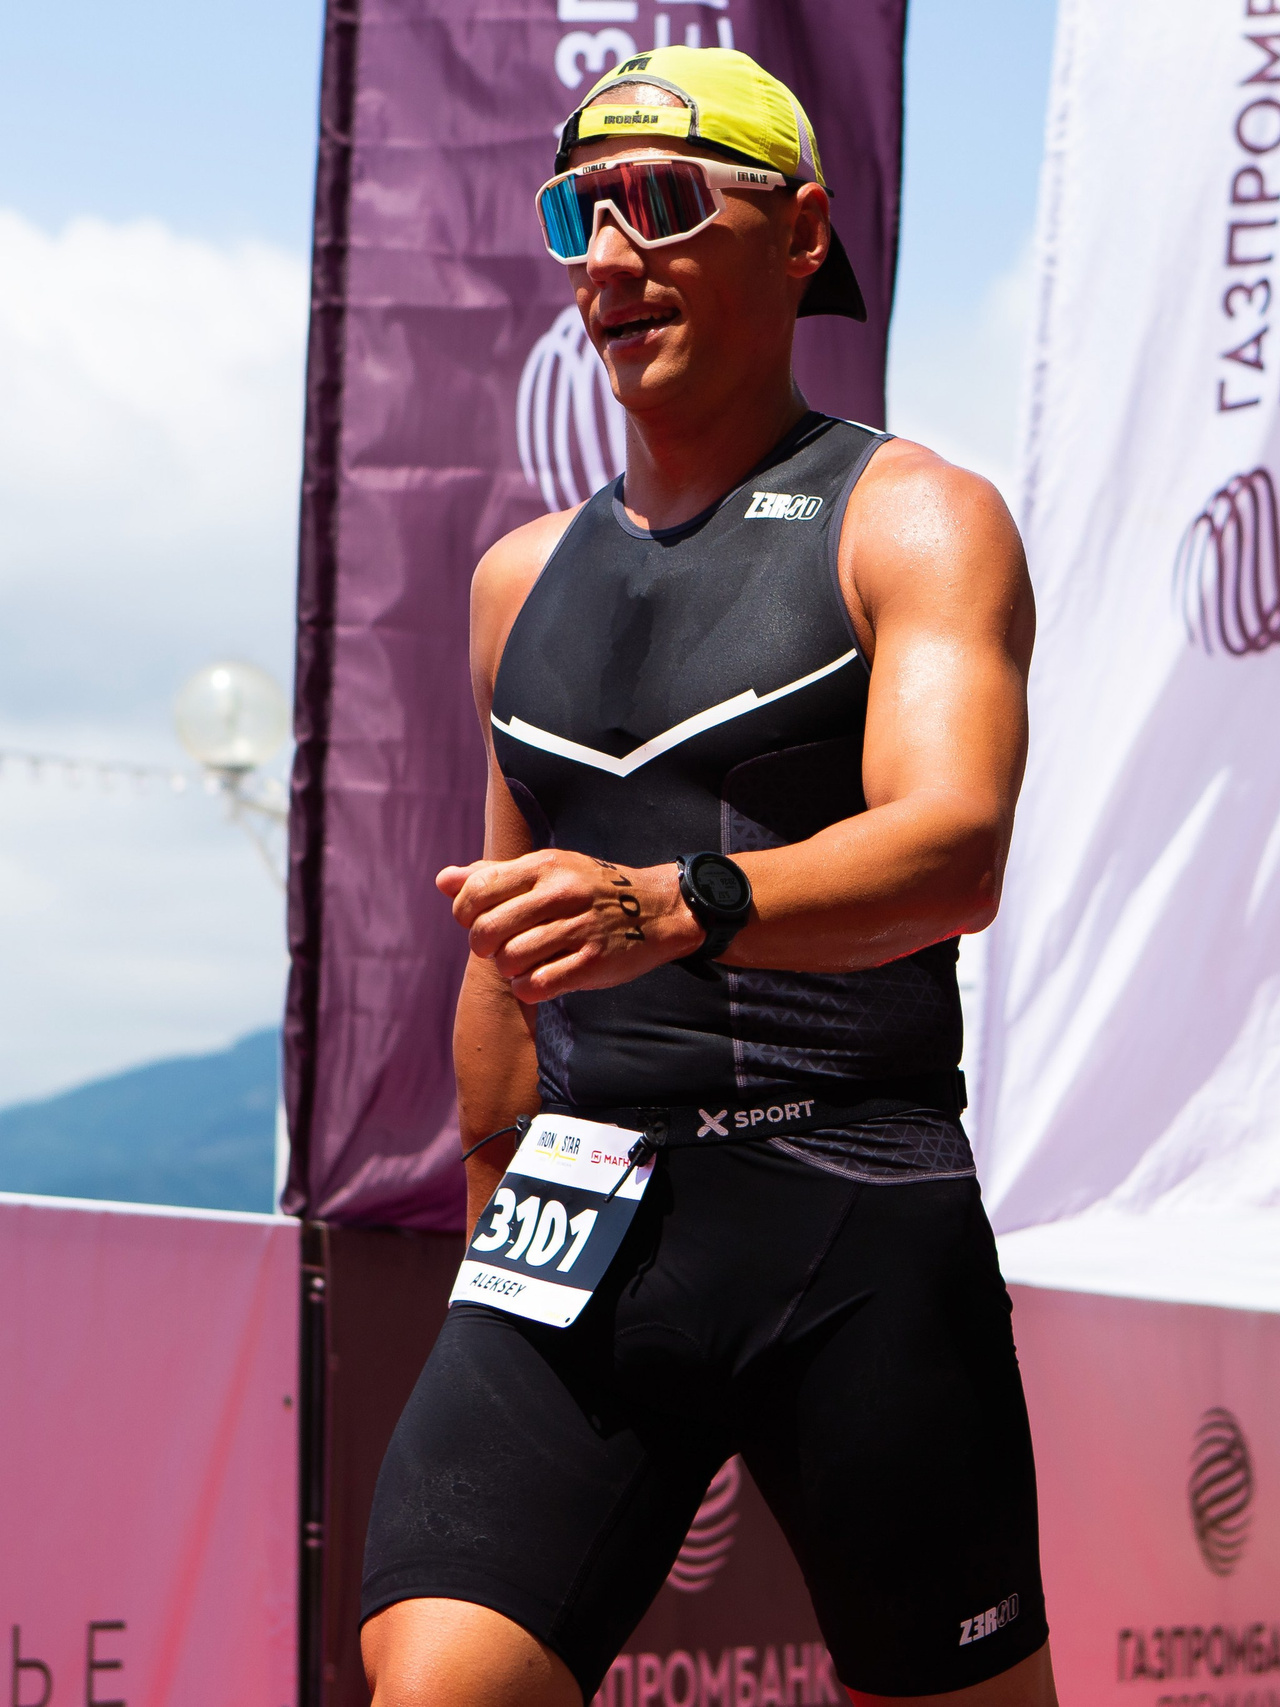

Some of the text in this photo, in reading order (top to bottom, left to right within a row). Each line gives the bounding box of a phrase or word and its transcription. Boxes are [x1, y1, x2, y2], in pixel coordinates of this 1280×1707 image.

[603, 111, 659, 125] IRONMAN
[733, 1099, 816, 1129] SPORT
[536, 1130, 581, 1155] IRON STAR
[603, 1154, 631, 1168] МАГН
[471, 1187, 599, 1273] 3101
[469, 1272, 527, 1299] ALEKSEY
[592, 1641, 842, 1707] ПРОМБАНК
